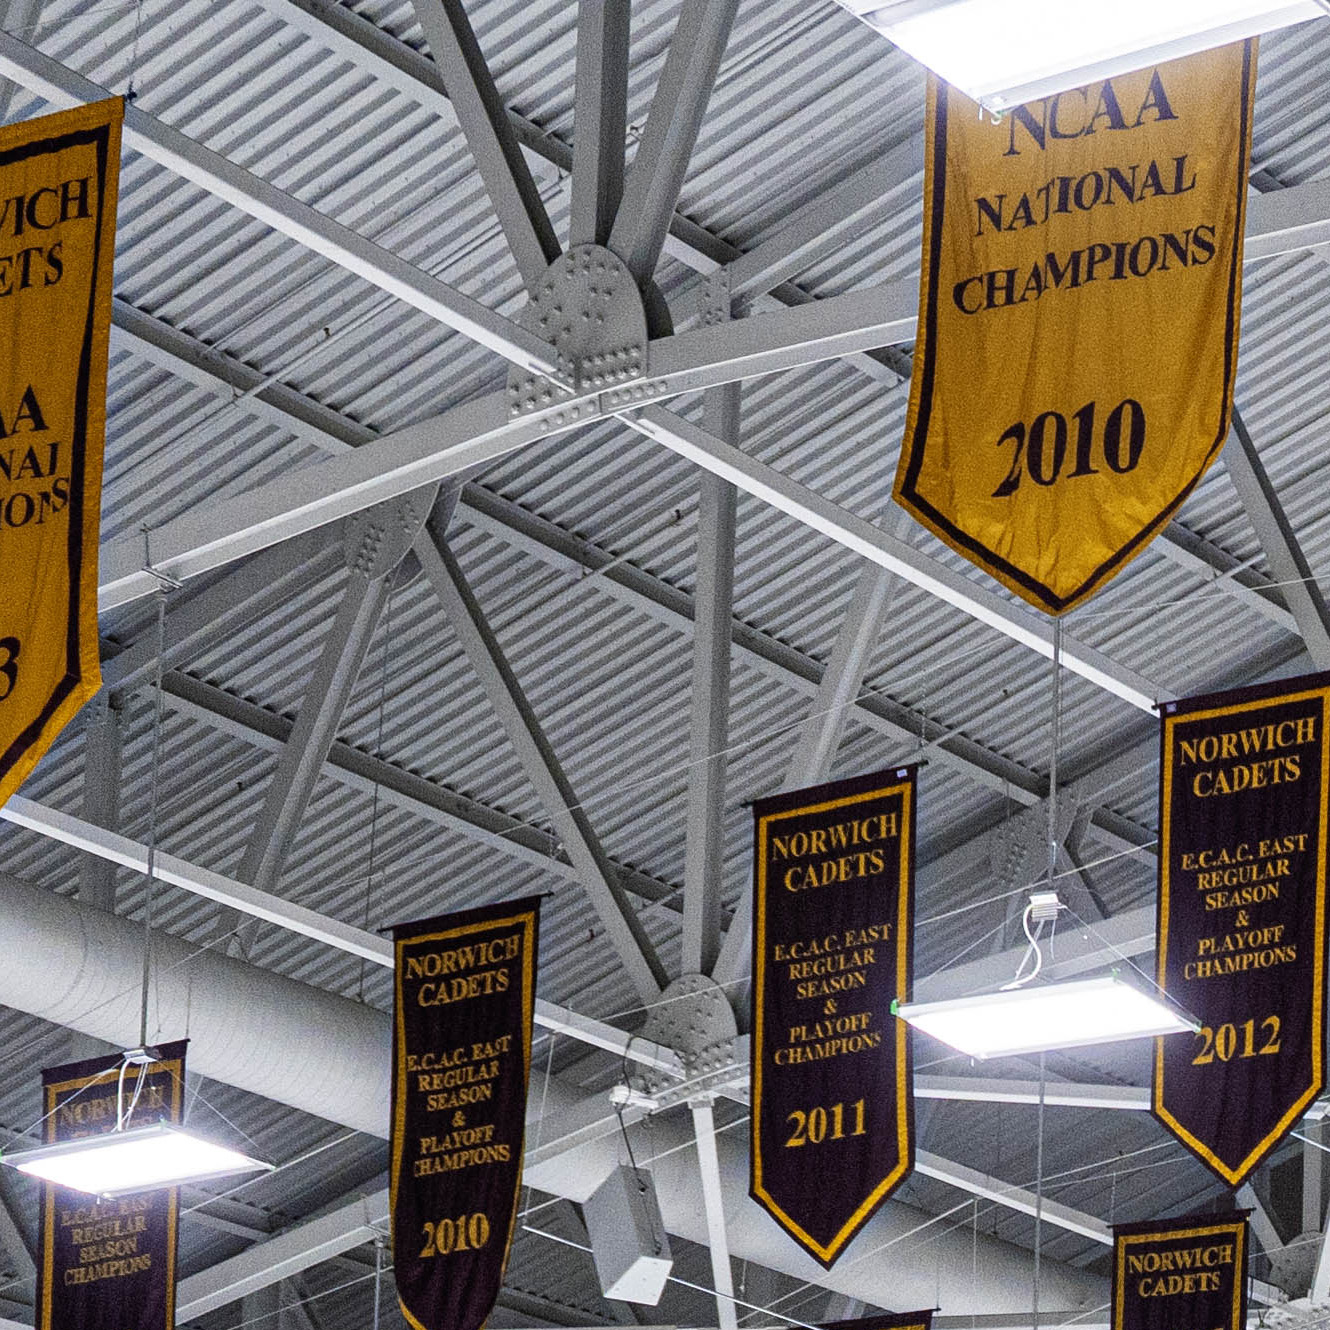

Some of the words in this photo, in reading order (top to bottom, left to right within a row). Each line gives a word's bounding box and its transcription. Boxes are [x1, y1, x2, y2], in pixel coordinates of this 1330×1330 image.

[1003, 68, 1178, 156] NCAA
[975, 155, 1196, 236] NATIONAL
[953, 225, 1215, 314] CHAMPIONS
[991, 399, 1146, 497] 2010
[1179, 716, 1316, 767] NORWICH
[1193, 754, 1301, 798] CADETS
[773, 812, 898, 861] NORWICH
[1181, 845, 1254, 871] E.C.A.C.
[1258, 834, 1307, 858] EAST
[784, 849, 885, 892] CADETS
[1198, 859, 1290, 891] REGULAR
[1206, 883, 1279, 910] SEASON
[1184, 945, 1297, 980] CHAMPIONS
[1199, 925, 1285, 956] PLAYOFF
[1192, 1015, 1281, 1065] 2012
[785, 1099, 867, 1148] 2011
[419, 1213, 489, 1258] 2010
[1128, 1244, 1233, 1274] NORWICH
[1139, 1272, 1220, 1297] CADETS
